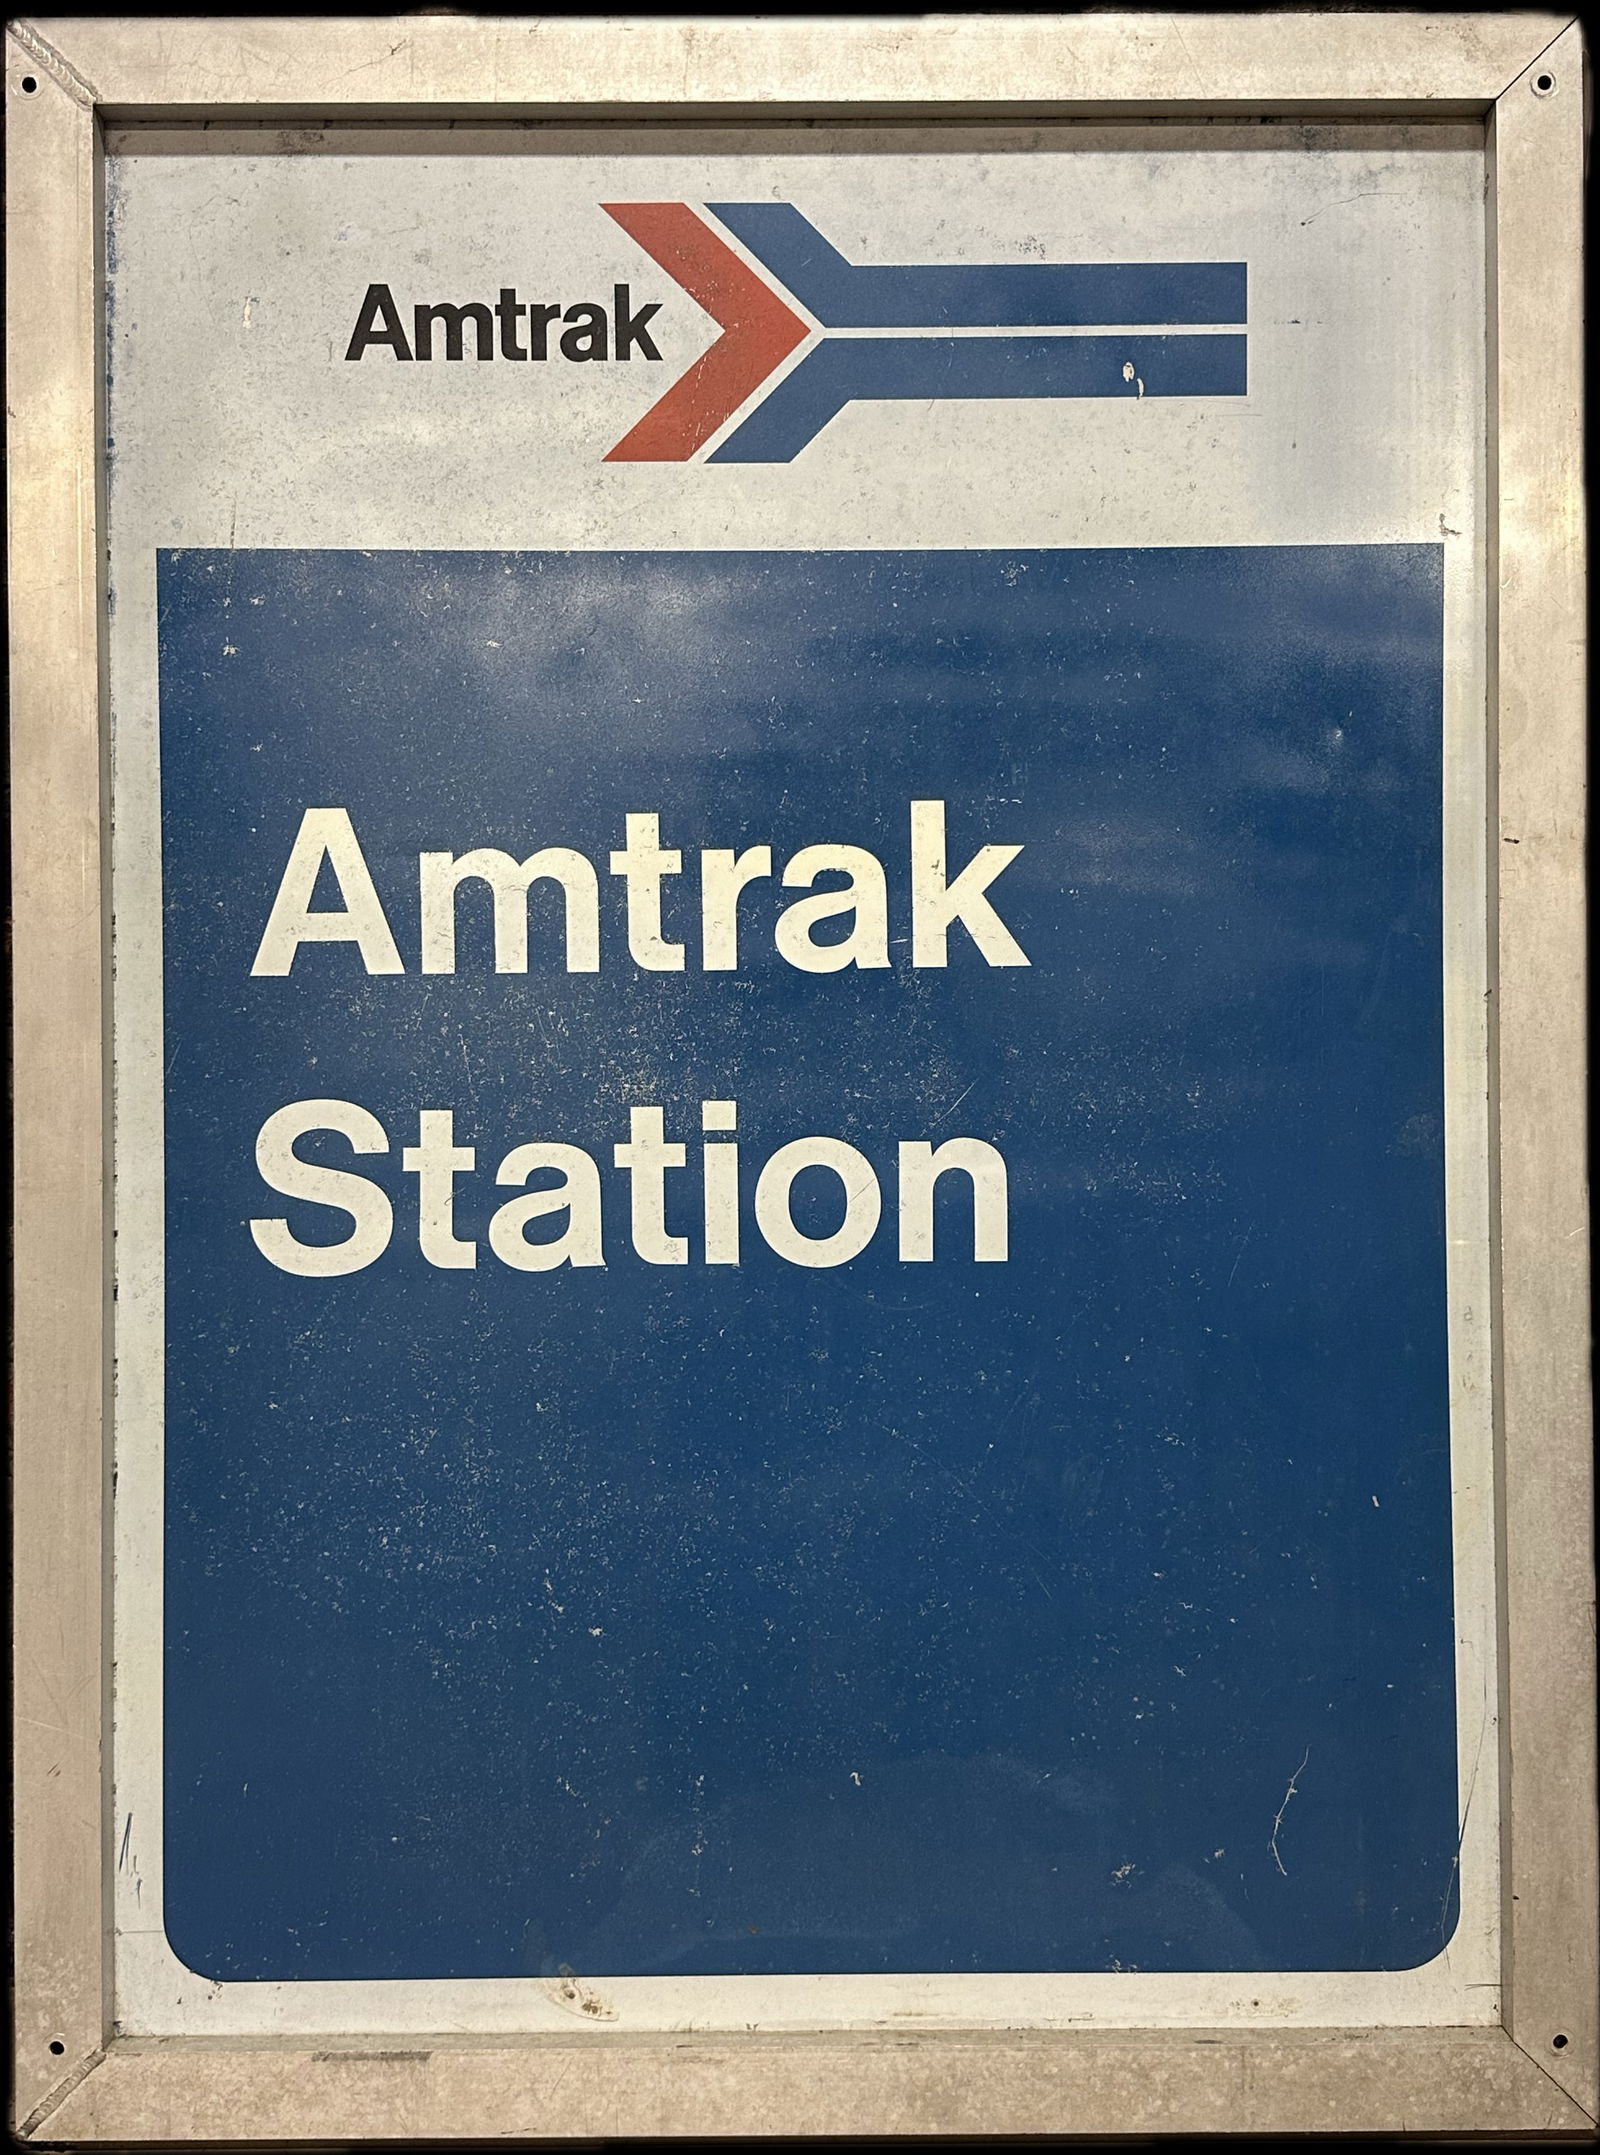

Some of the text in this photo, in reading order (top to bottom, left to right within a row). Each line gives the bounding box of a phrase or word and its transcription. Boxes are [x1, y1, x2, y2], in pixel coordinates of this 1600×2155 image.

[345, 284, 663, 362] Amtrak
[250, 800, 1032, 976] Amtrak
[249, 1099, 1009, 1277] Station
